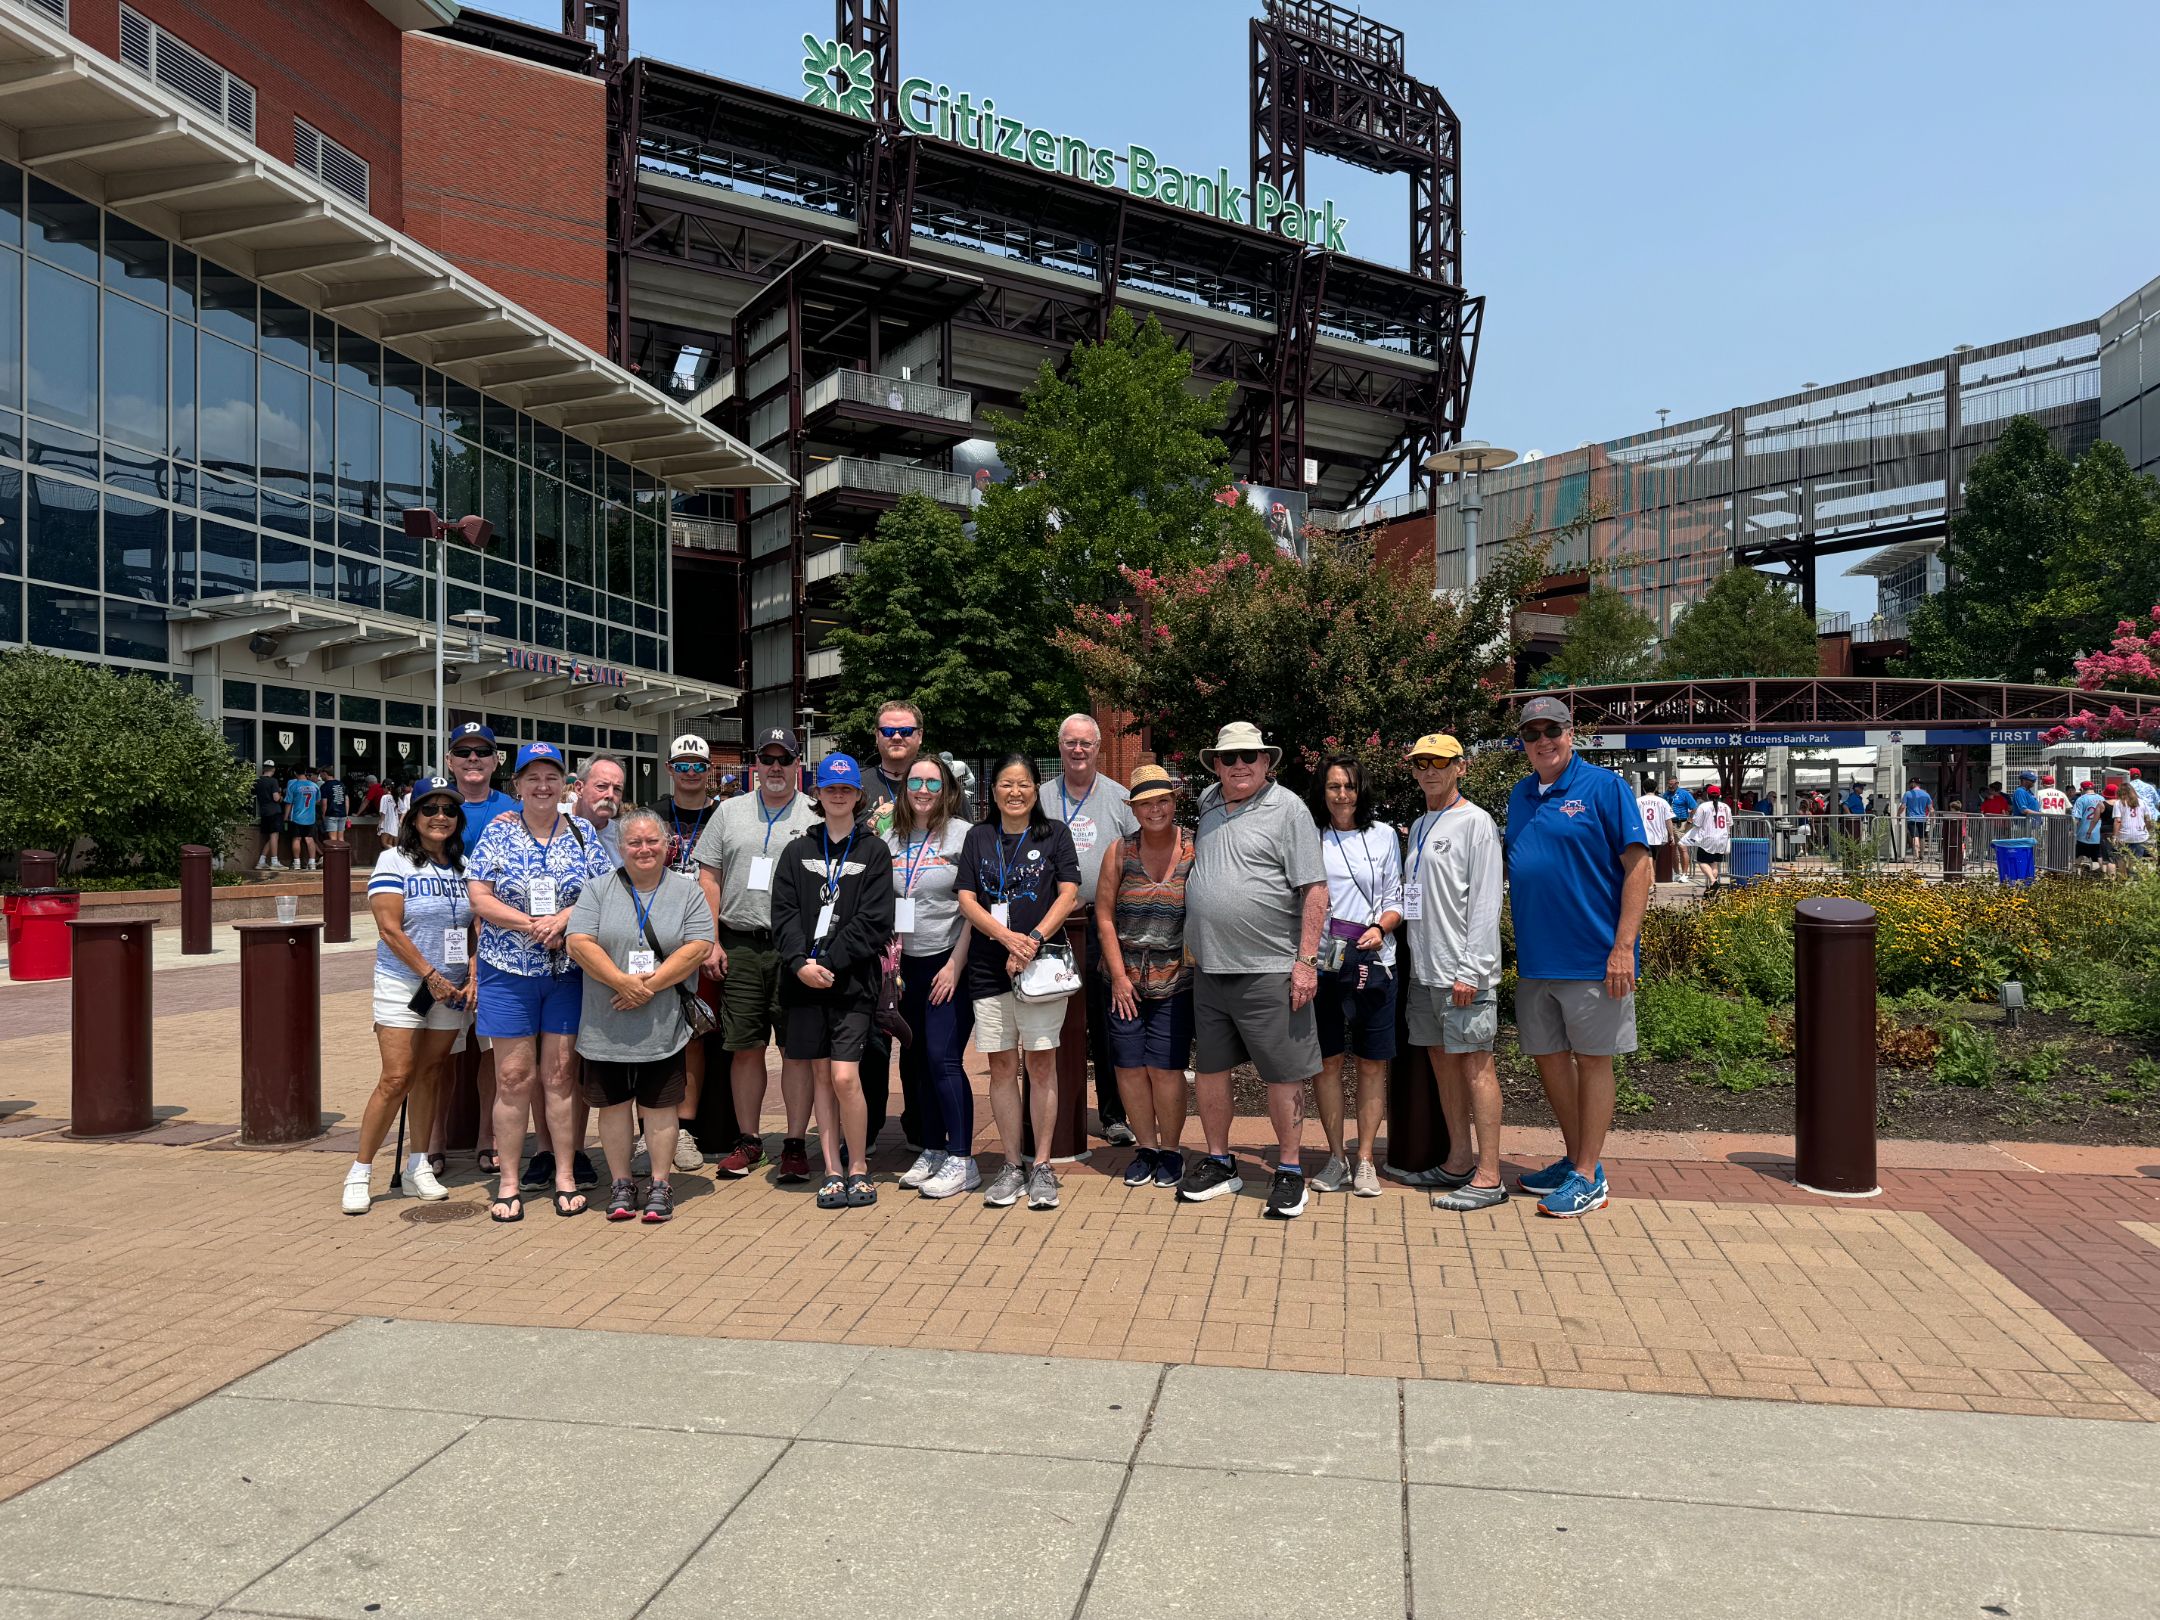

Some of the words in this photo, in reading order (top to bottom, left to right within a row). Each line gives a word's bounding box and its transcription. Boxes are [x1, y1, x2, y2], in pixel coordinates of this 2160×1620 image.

[898, 77, 1116, 187] Citizens
[1127, 143, 1246, 225] Bank
[1255, 182, 1349, 254] Park
[507, 647, 560, 675] TICKET
[589, 663, 627, 687] SALES
[283, 733, 290, 744] 21
[1660, 735, 1712, 745] Welcome
[1714, 736, 1726, 745] to
[1744, 735, 1782, 744] Citizens
[1783, 733, 1808, 743] Bank
[1809, 733, 1830, 743] Park
[1990, 731, 2032, 741] FIRST
[356, 740, 363, 750] 22
[683, 740, 699, 751] M
[1646, 808, 1655, 820] 3
